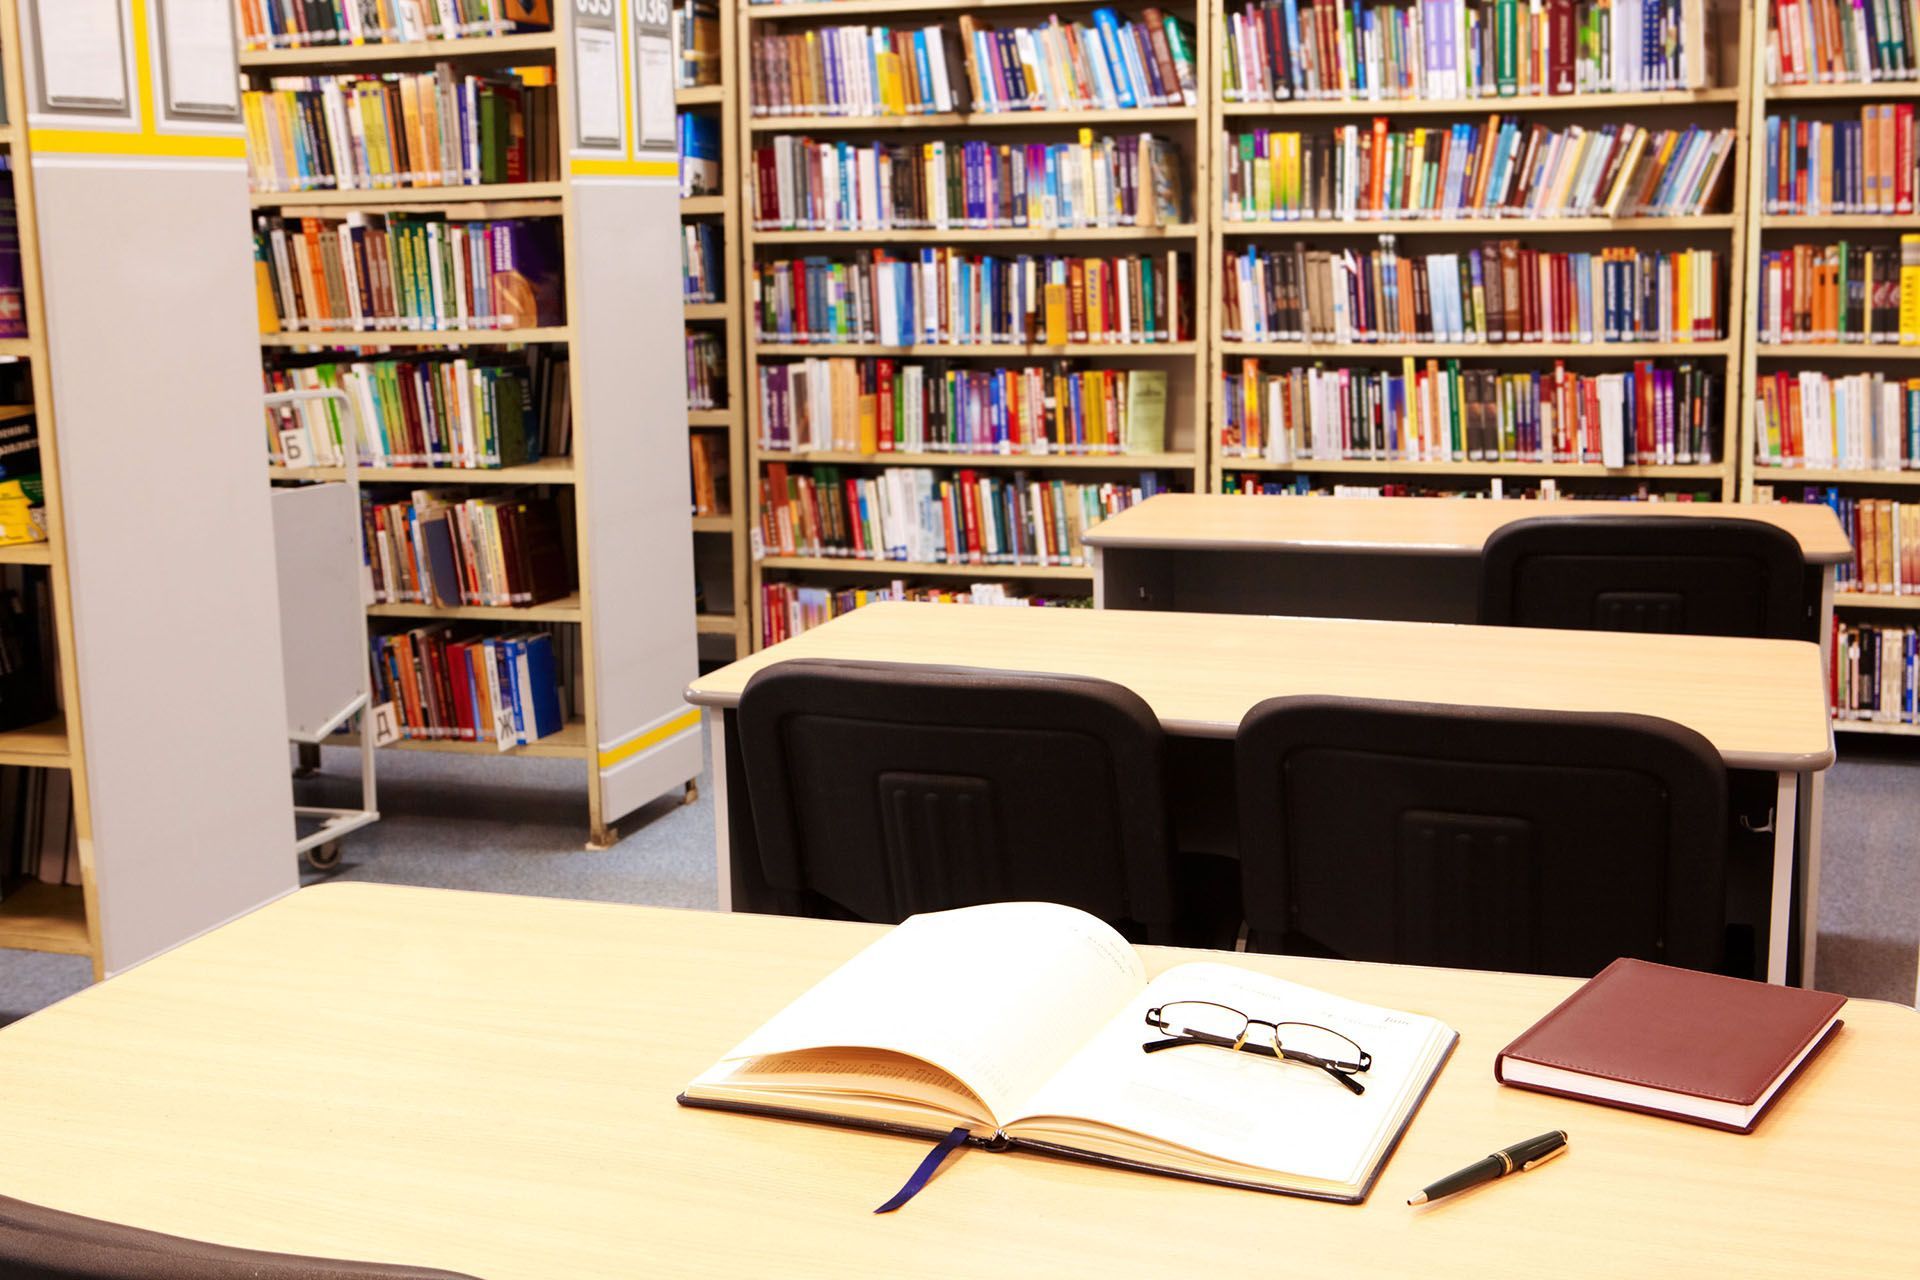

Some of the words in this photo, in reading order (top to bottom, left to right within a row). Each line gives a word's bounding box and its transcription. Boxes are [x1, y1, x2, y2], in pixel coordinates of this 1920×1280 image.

[284, 434, 301, 460] Б
[376, 711, 393, 742] Д
[498, 711, 514, 740] Ж
